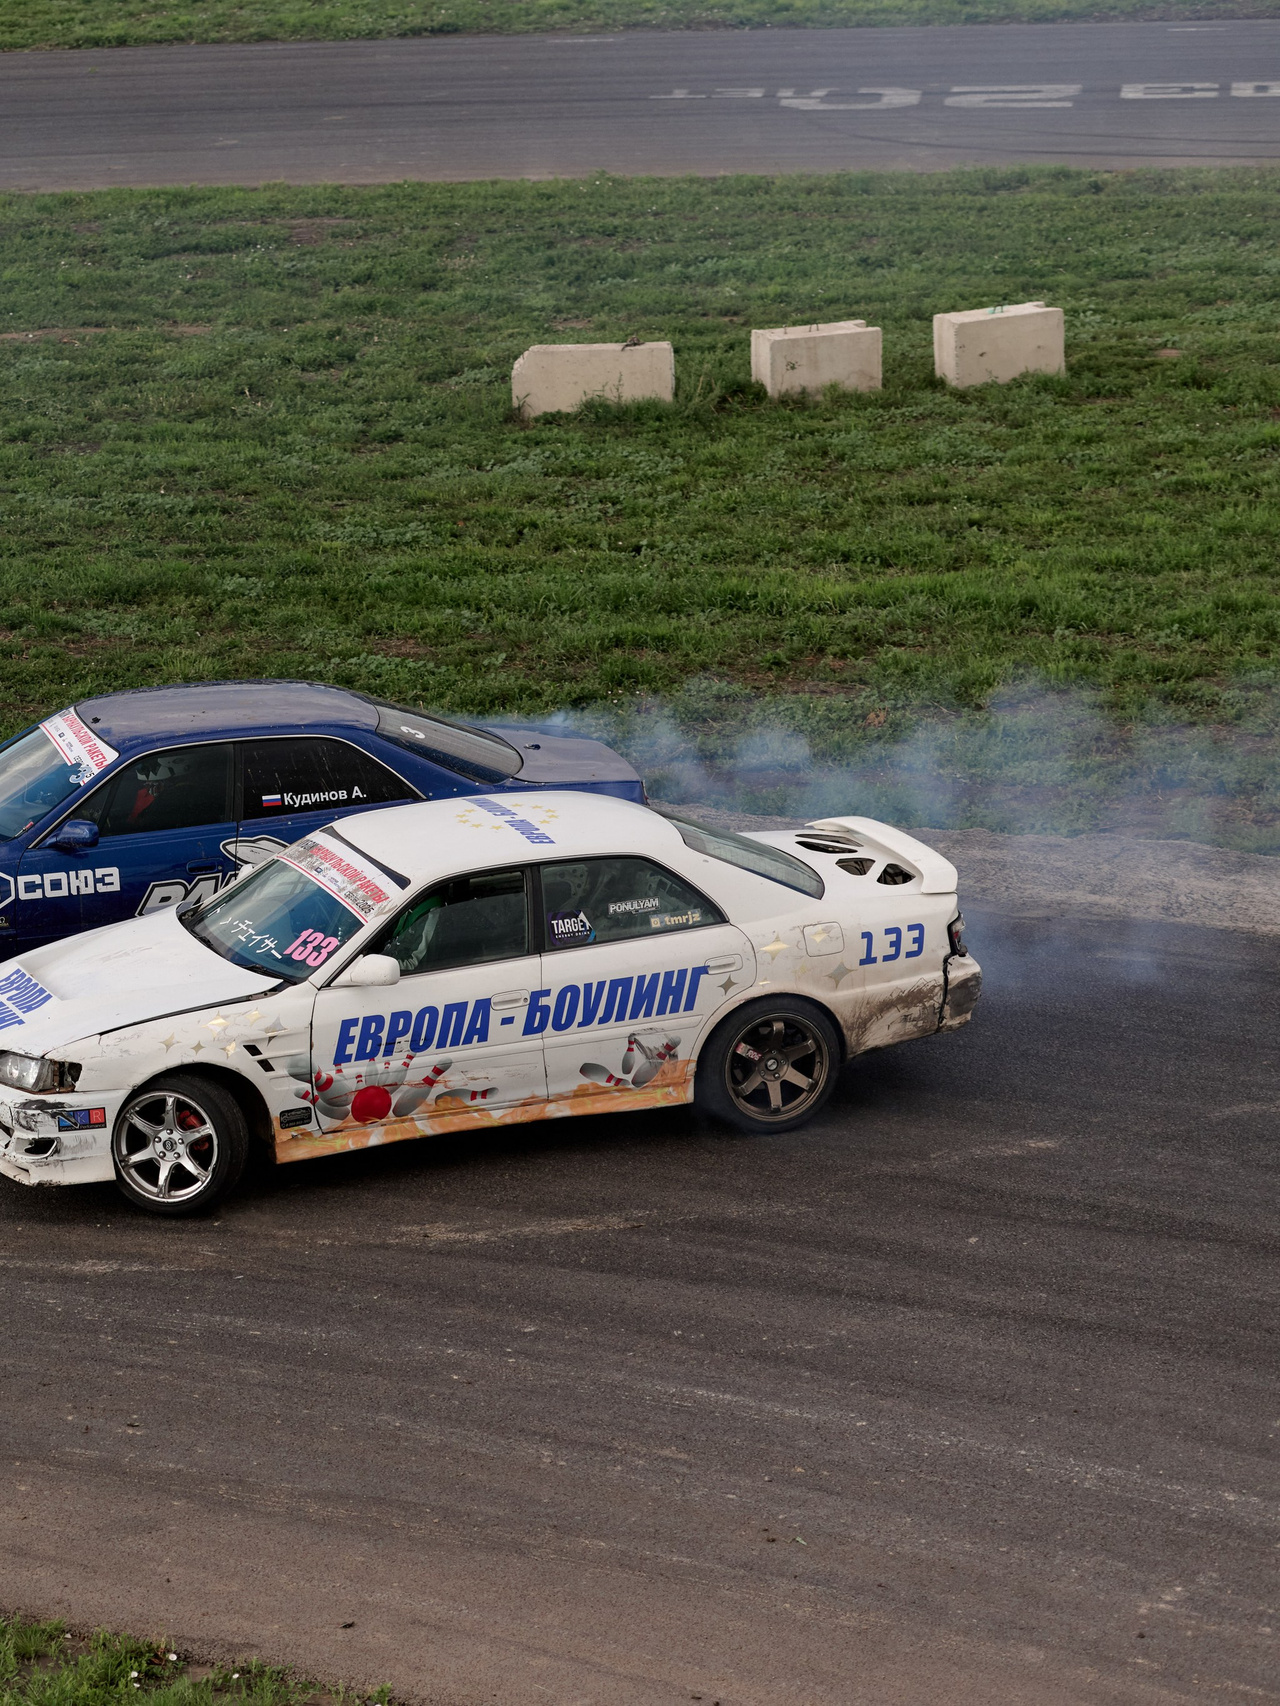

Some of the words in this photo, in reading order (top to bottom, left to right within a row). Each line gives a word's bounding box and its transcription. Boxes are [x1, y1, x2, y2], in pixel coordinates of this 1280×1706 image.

[84, 742, 109, 770] РАКЕТЫ
[284, 789, 348, 807] Кудинов
[351, 785, 367, 799] А.
[17, 867, 121, 900] СОЮЗ
[355, 875, 391, 905] РАКЕТЫ
[551, 911, 593, 934] TARGET
[664, 911, 700, 925] tmrjz
[283, 928, 339, 967] 133
[858, 923, 925, 966] 133
[333, 997, 492, 1065] ЕВРОПА
[521, 965, 710, 1037] БОУЛИНГ
